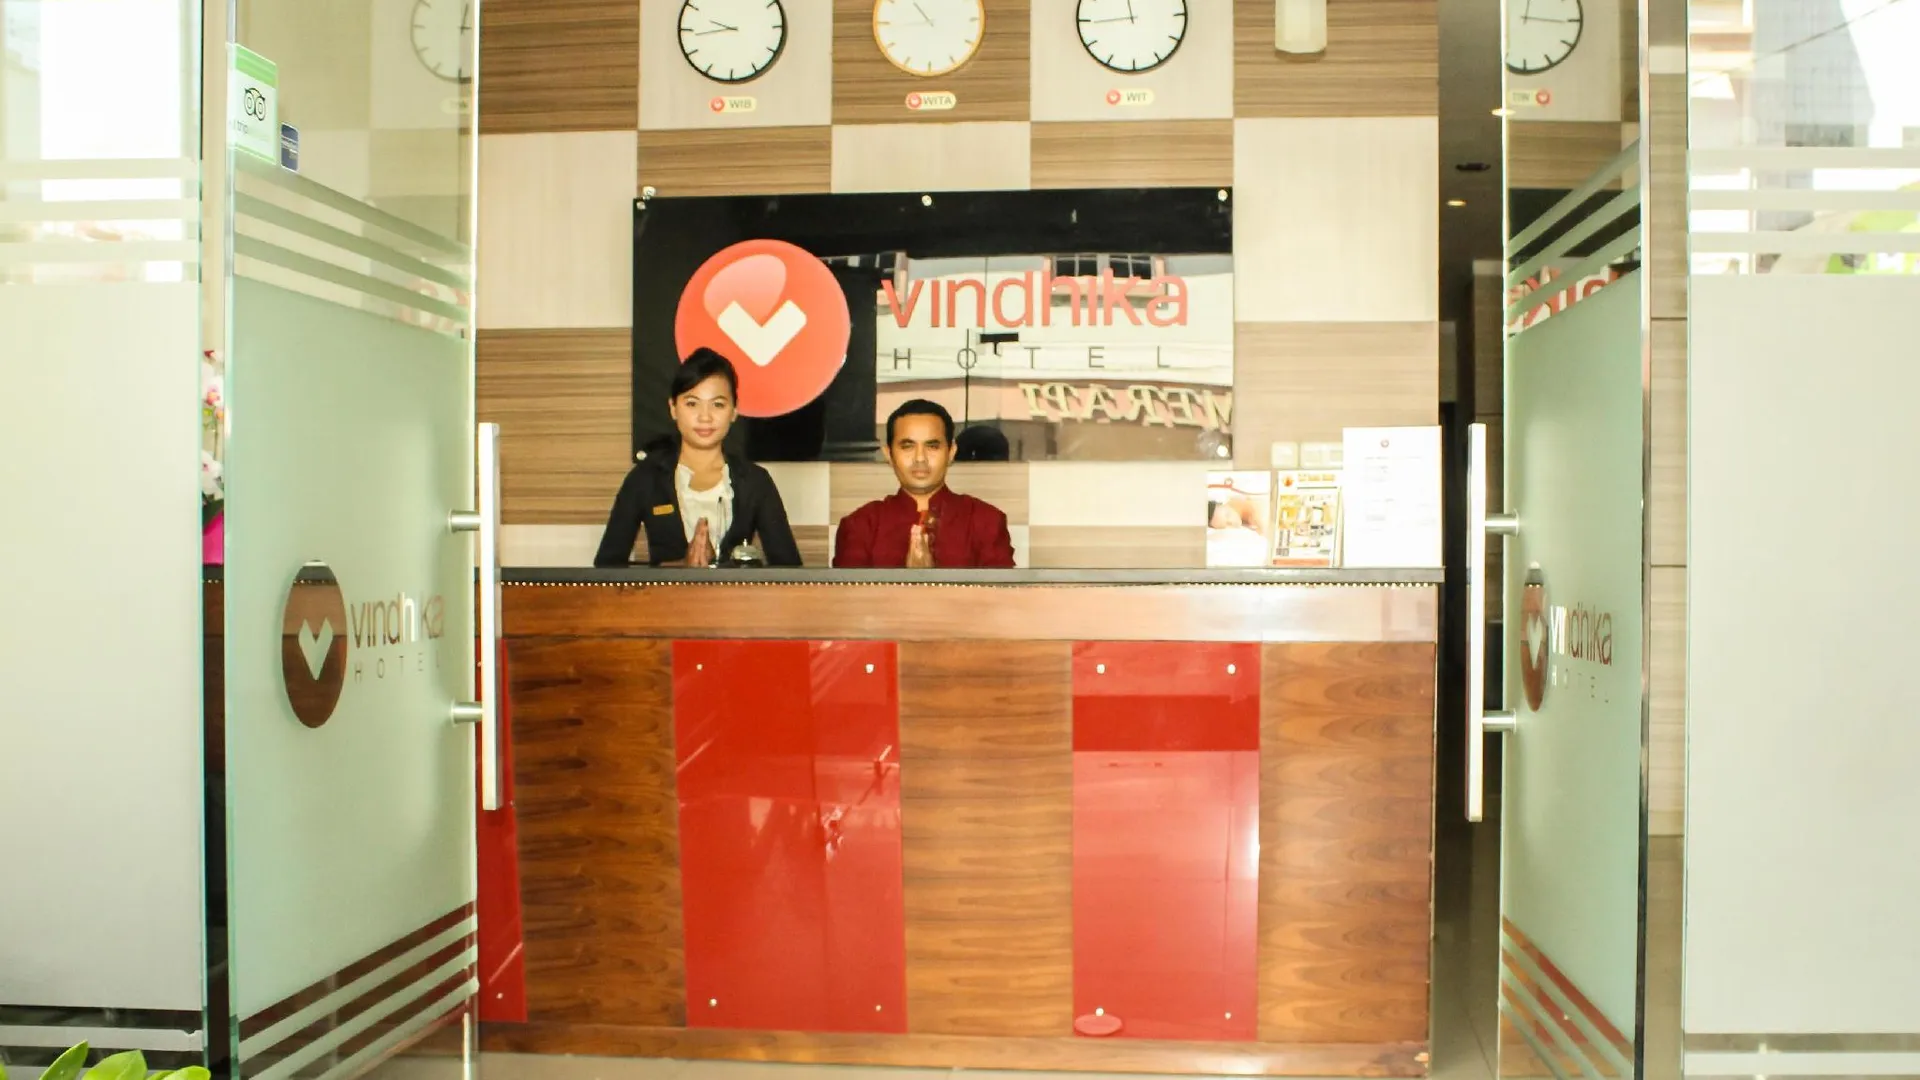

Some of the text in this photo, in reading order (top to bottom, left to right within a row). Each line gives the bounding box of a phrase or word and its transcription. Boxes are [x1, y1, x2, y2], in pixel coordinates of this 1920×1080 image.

[923, 95, 952, 106] WITA
[1125, 91, 1147, 102] WIT
[728, 99, 752, 109] WIB
[881, 267, 1188, 328] vindhika
[893, 346, 1170, 370] HOTEL
